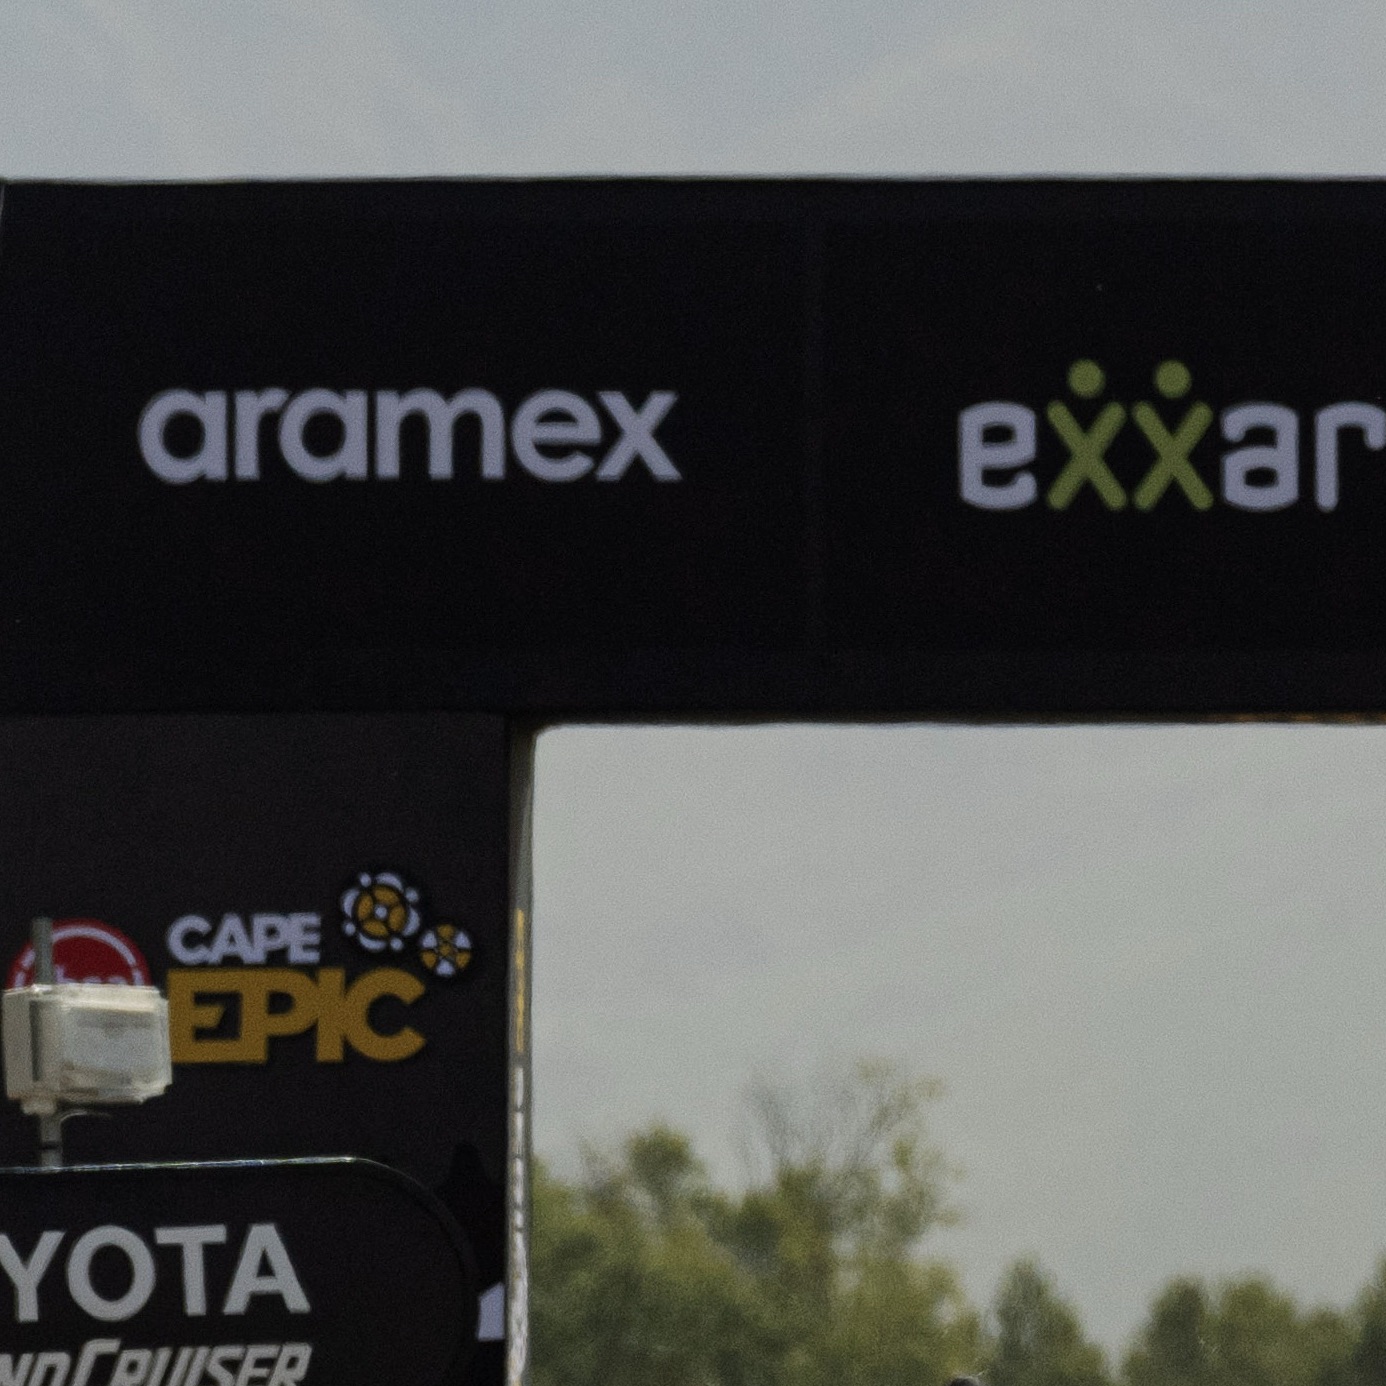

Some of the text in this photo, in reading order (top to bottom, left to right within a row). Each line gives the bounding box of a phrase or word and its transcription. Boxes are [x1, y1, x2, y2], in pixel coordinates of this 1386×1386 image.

[138, 386, 683, 485] aramex
[166, 912, 321, 966] CAPE
[167, 966, 427, 1064] EPIC
